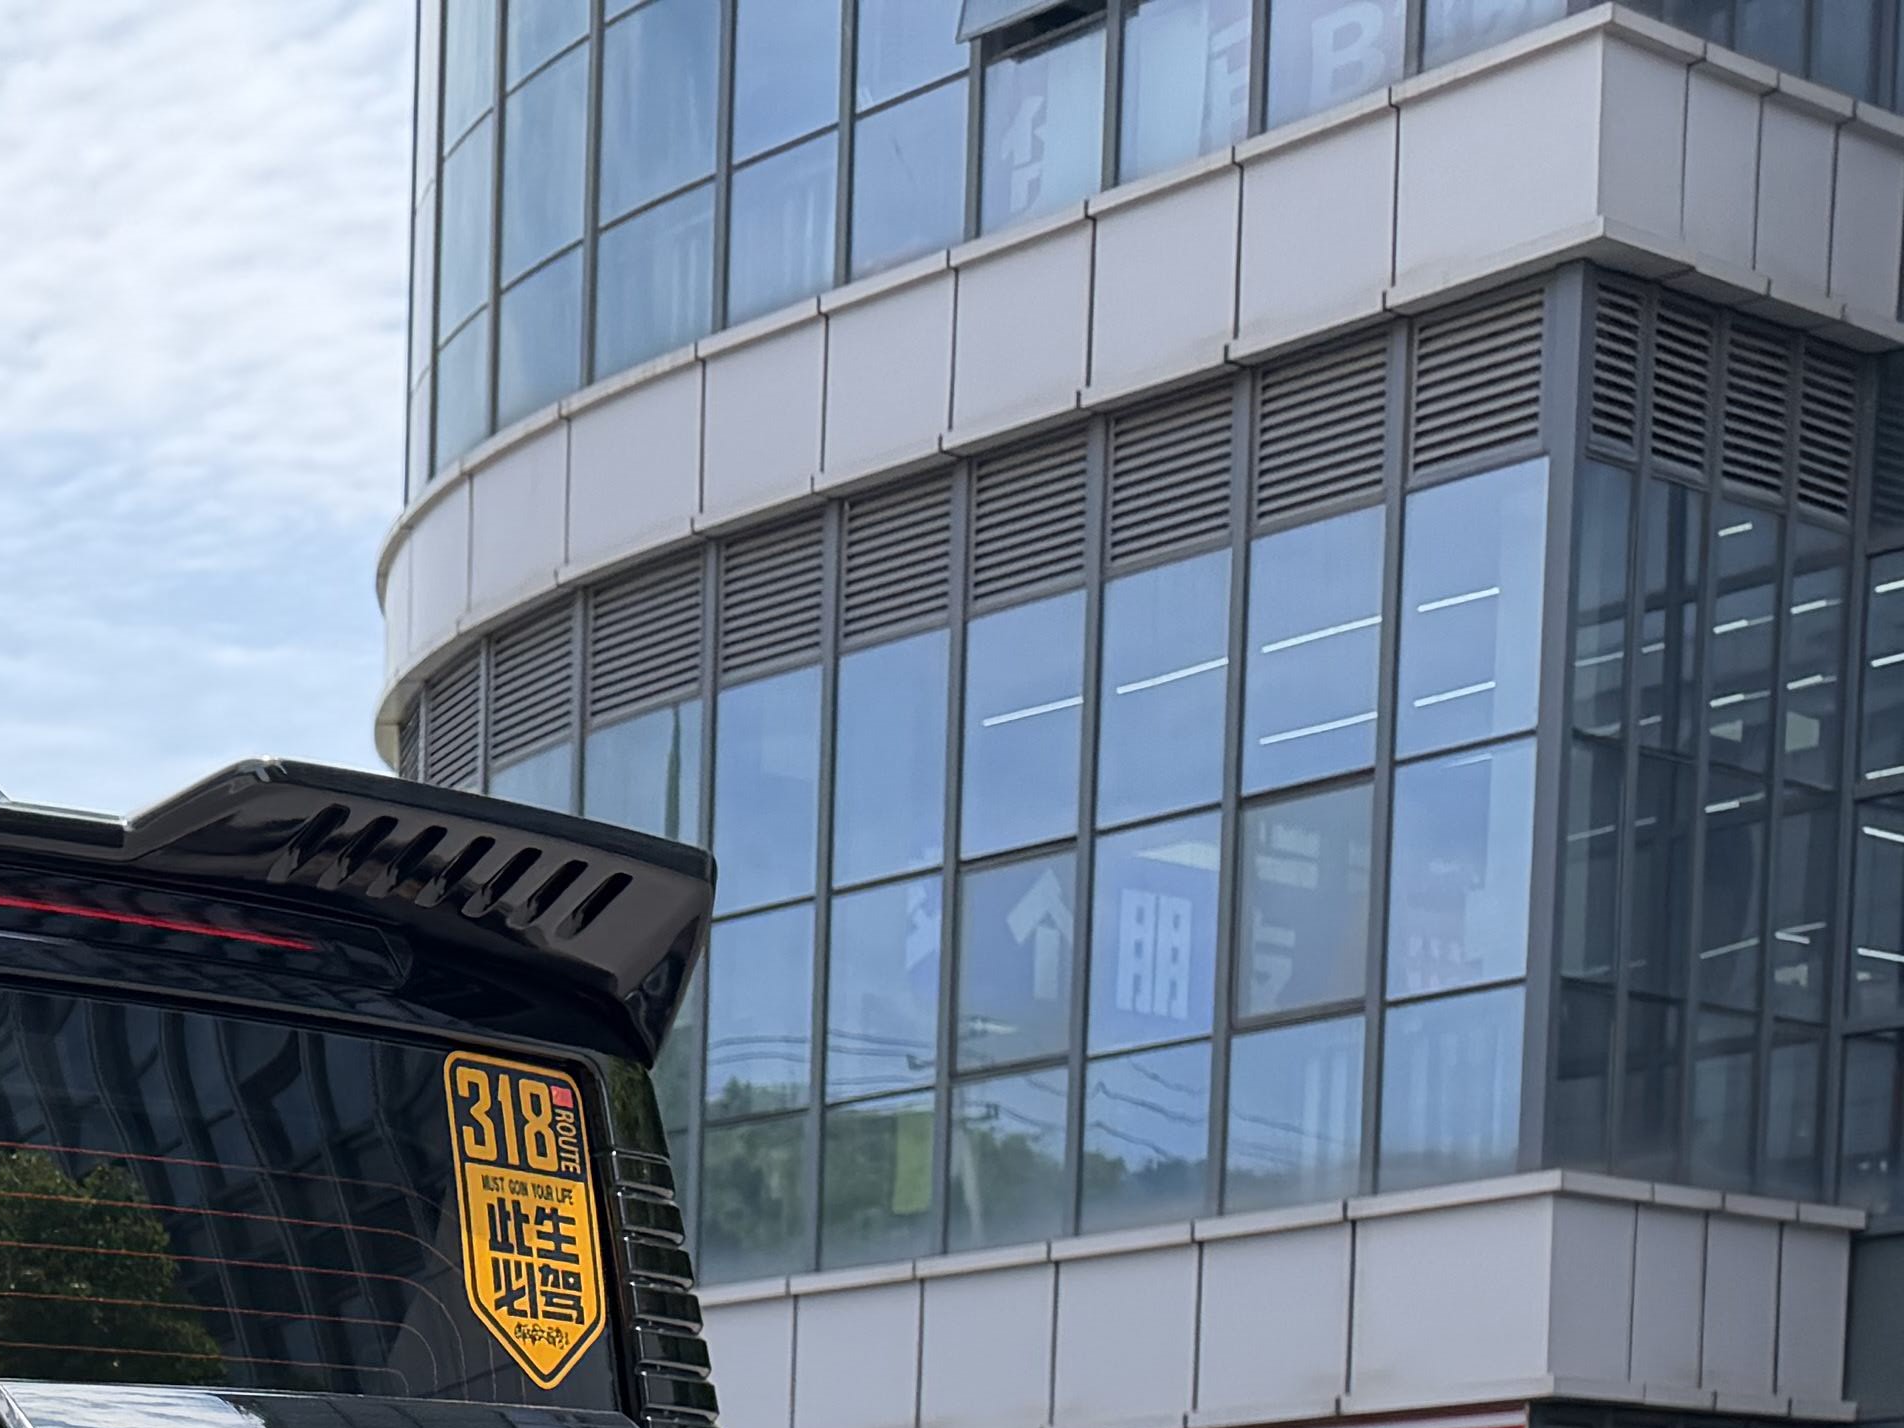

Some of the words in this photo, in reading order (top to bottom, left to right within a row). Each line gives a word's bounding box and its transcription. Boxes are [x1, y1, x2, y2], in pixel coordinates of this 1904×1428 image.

[456, 1065, 559, 1172] 318
[555, 1109, 581, 1175] ROUTE
[486, 1196, 580, 1265] 此生
[490, 1256, 585, 1326] 必驾
